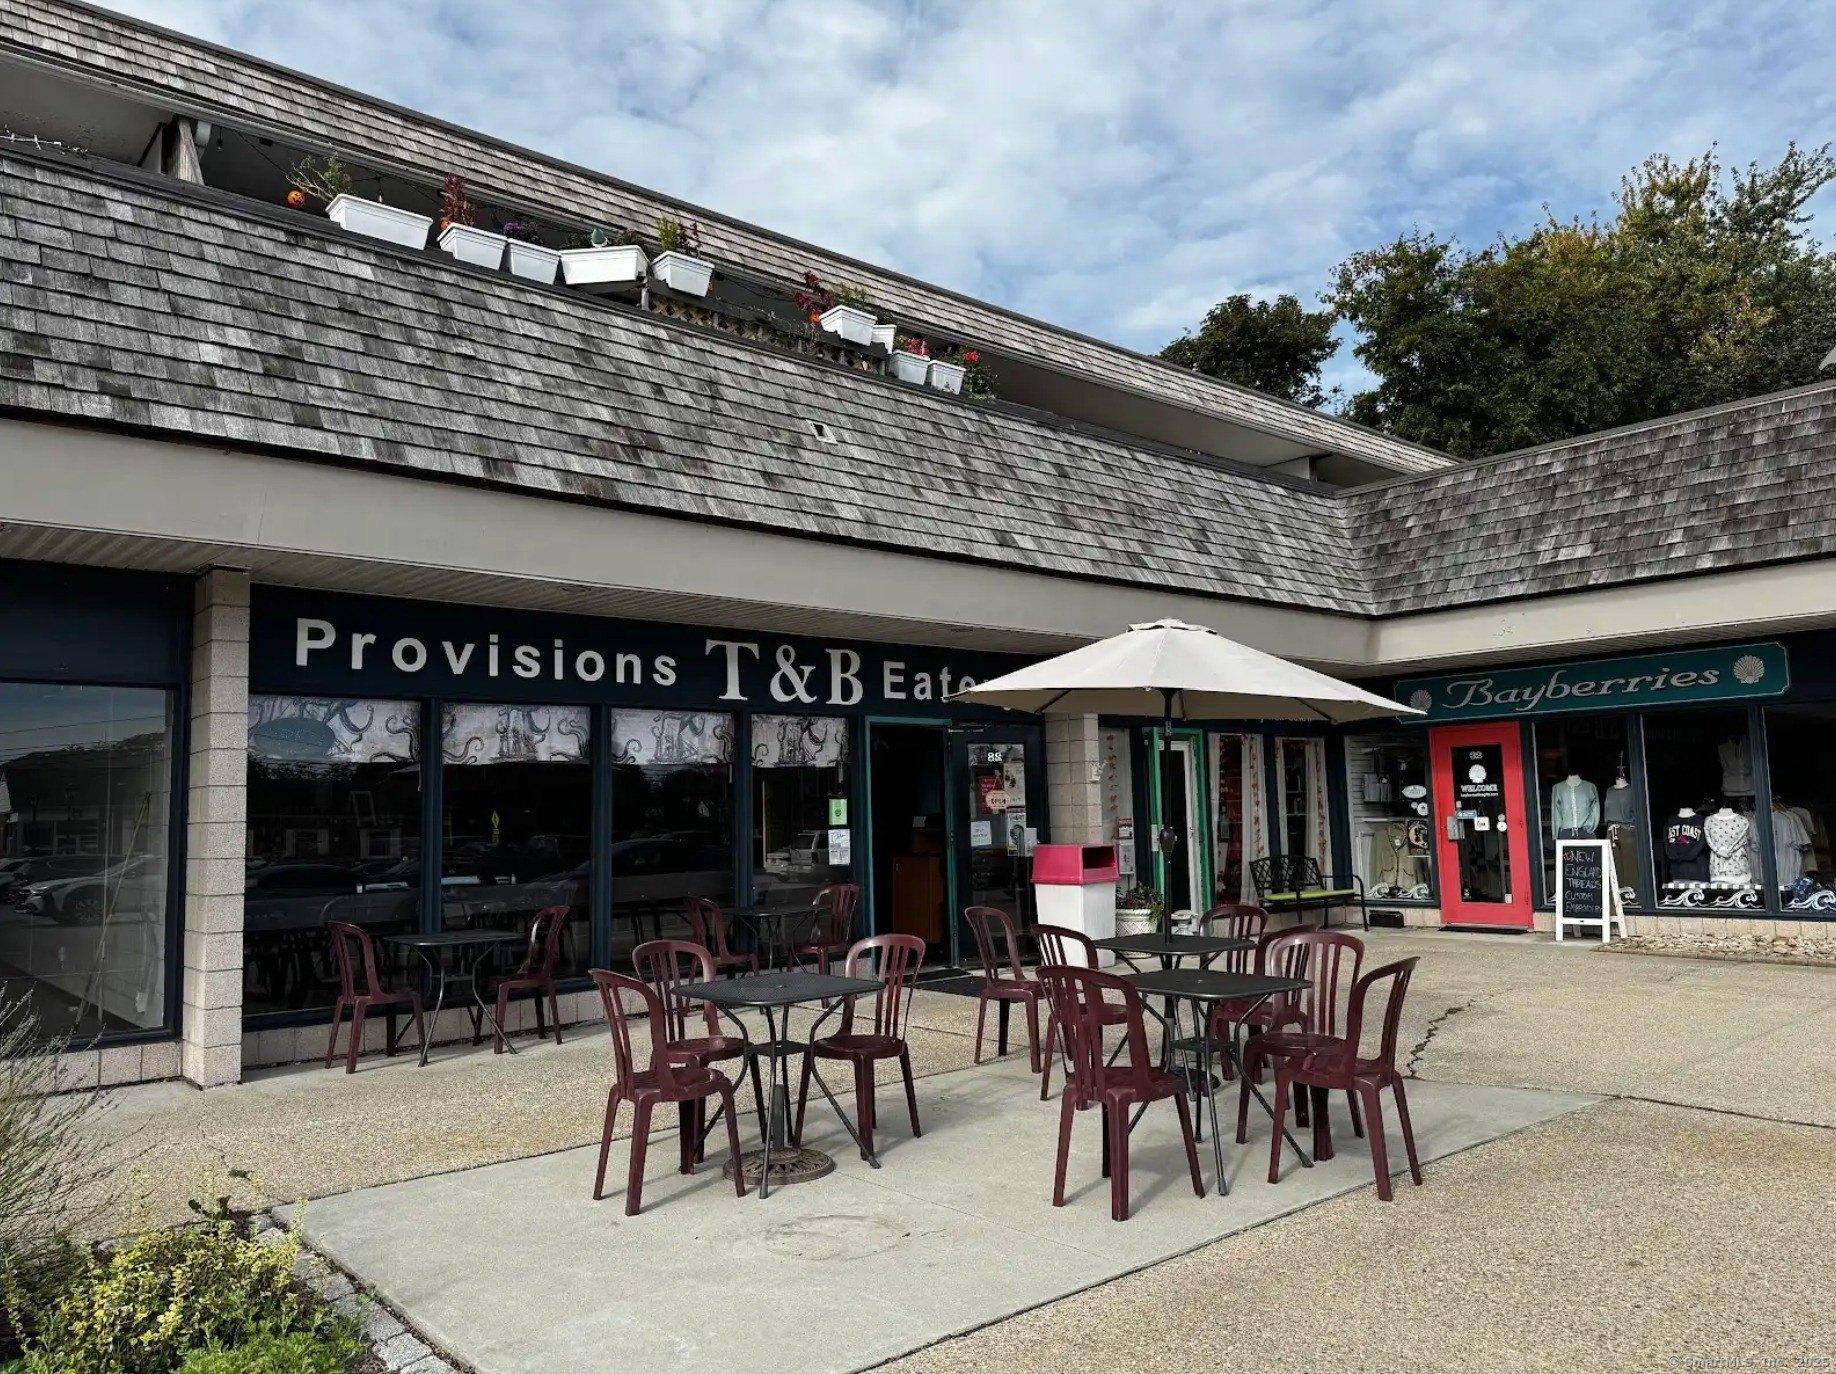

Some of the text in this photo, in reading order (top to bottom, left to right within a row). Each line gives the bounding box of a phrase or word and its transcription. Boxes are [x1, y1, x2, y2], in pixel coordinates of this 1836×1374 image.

[296, 617, 1000, 706] Provisions T&B Eate
[1442, 667, 1720, 711] Bayberries
[1461, 783, 1498, 793] WELCOME
[1668, 825, 1681, 839] AST
[1570, 850, 1595, 862] NEW
